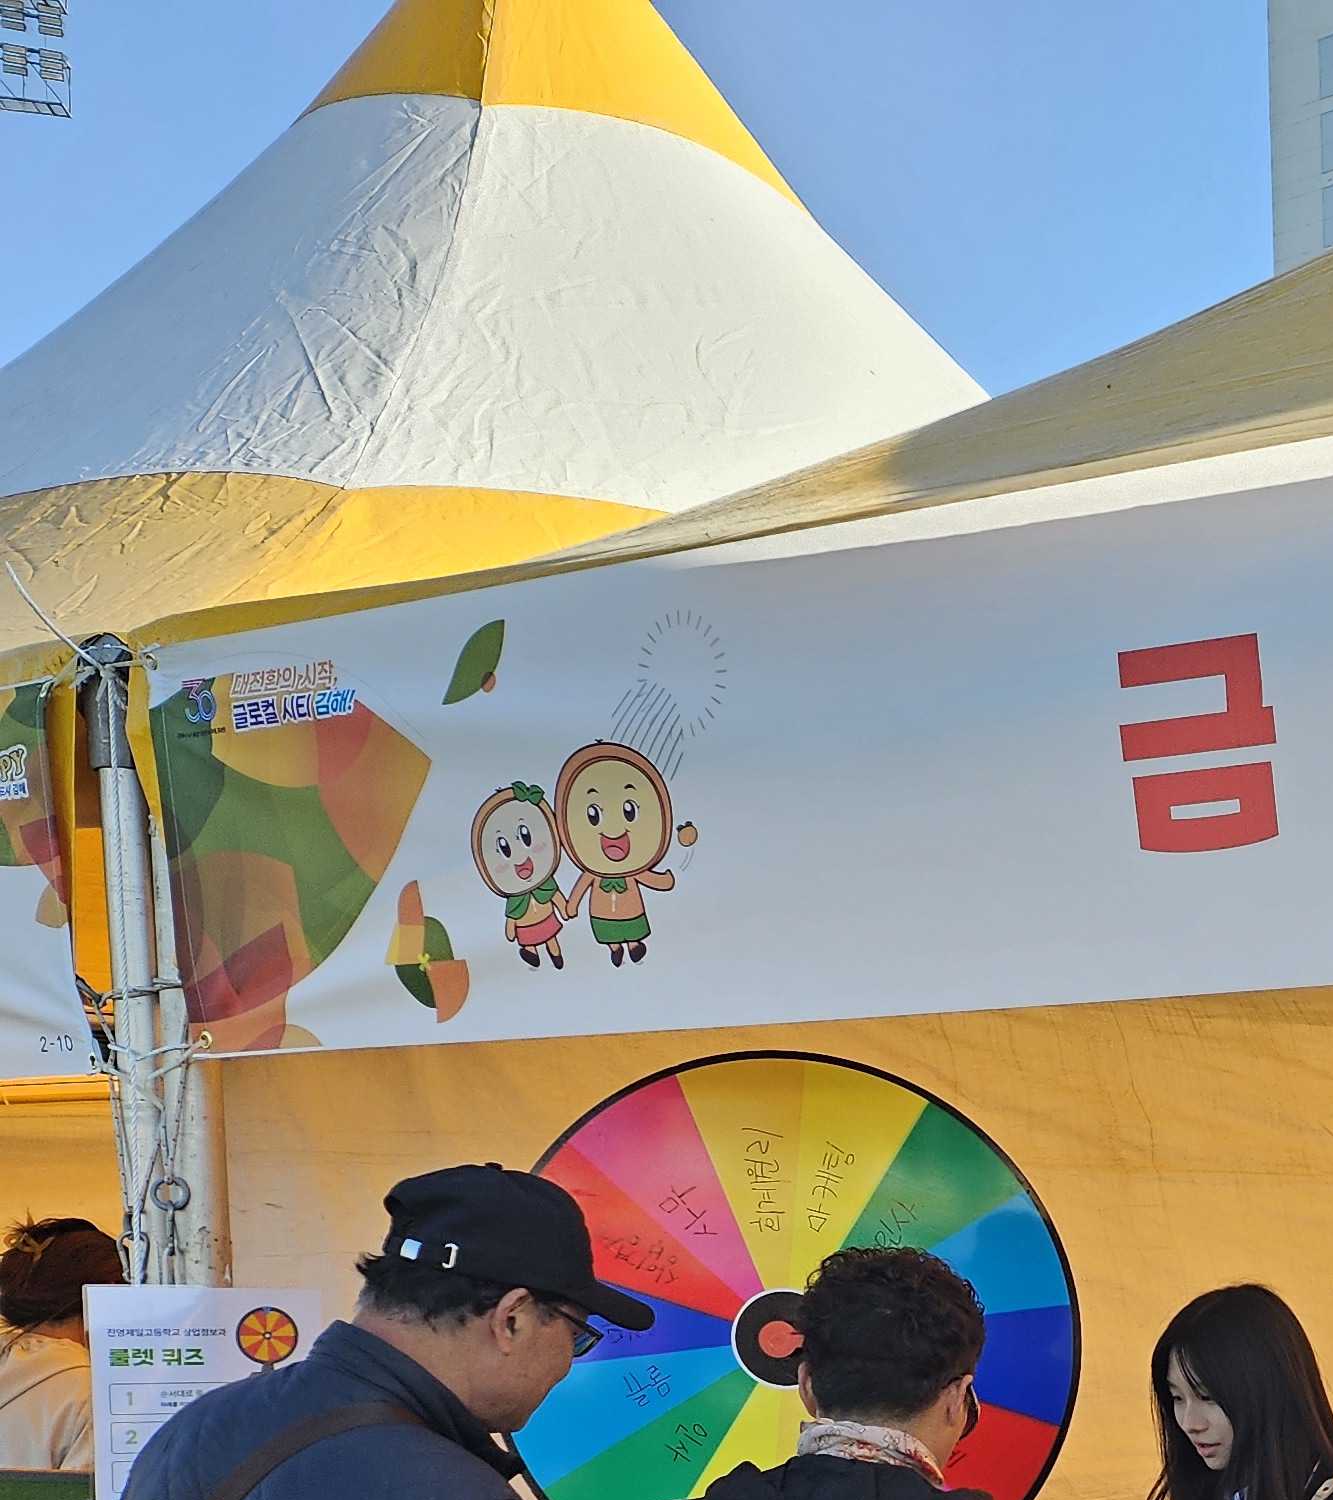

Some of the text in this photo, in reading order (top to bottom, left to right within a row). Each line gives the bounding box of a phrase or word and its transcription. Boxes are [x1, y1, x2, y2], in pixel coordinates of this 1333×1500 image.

[231, 666, 296, 697] 대전환의
[233, 689, 356, 730] 글로컬 시티 김해!
[39, 1034, 74, 1055] 2-10
[807, 1141, 856, 1233] 마케팅
[108, 1348, 205, 1367] 룰렛 퀴즈
[622, 1364, 673, 1408] 물류
[125, 1429, 138, 1445] 2
[665, 1421, 708, 1463] 인사
